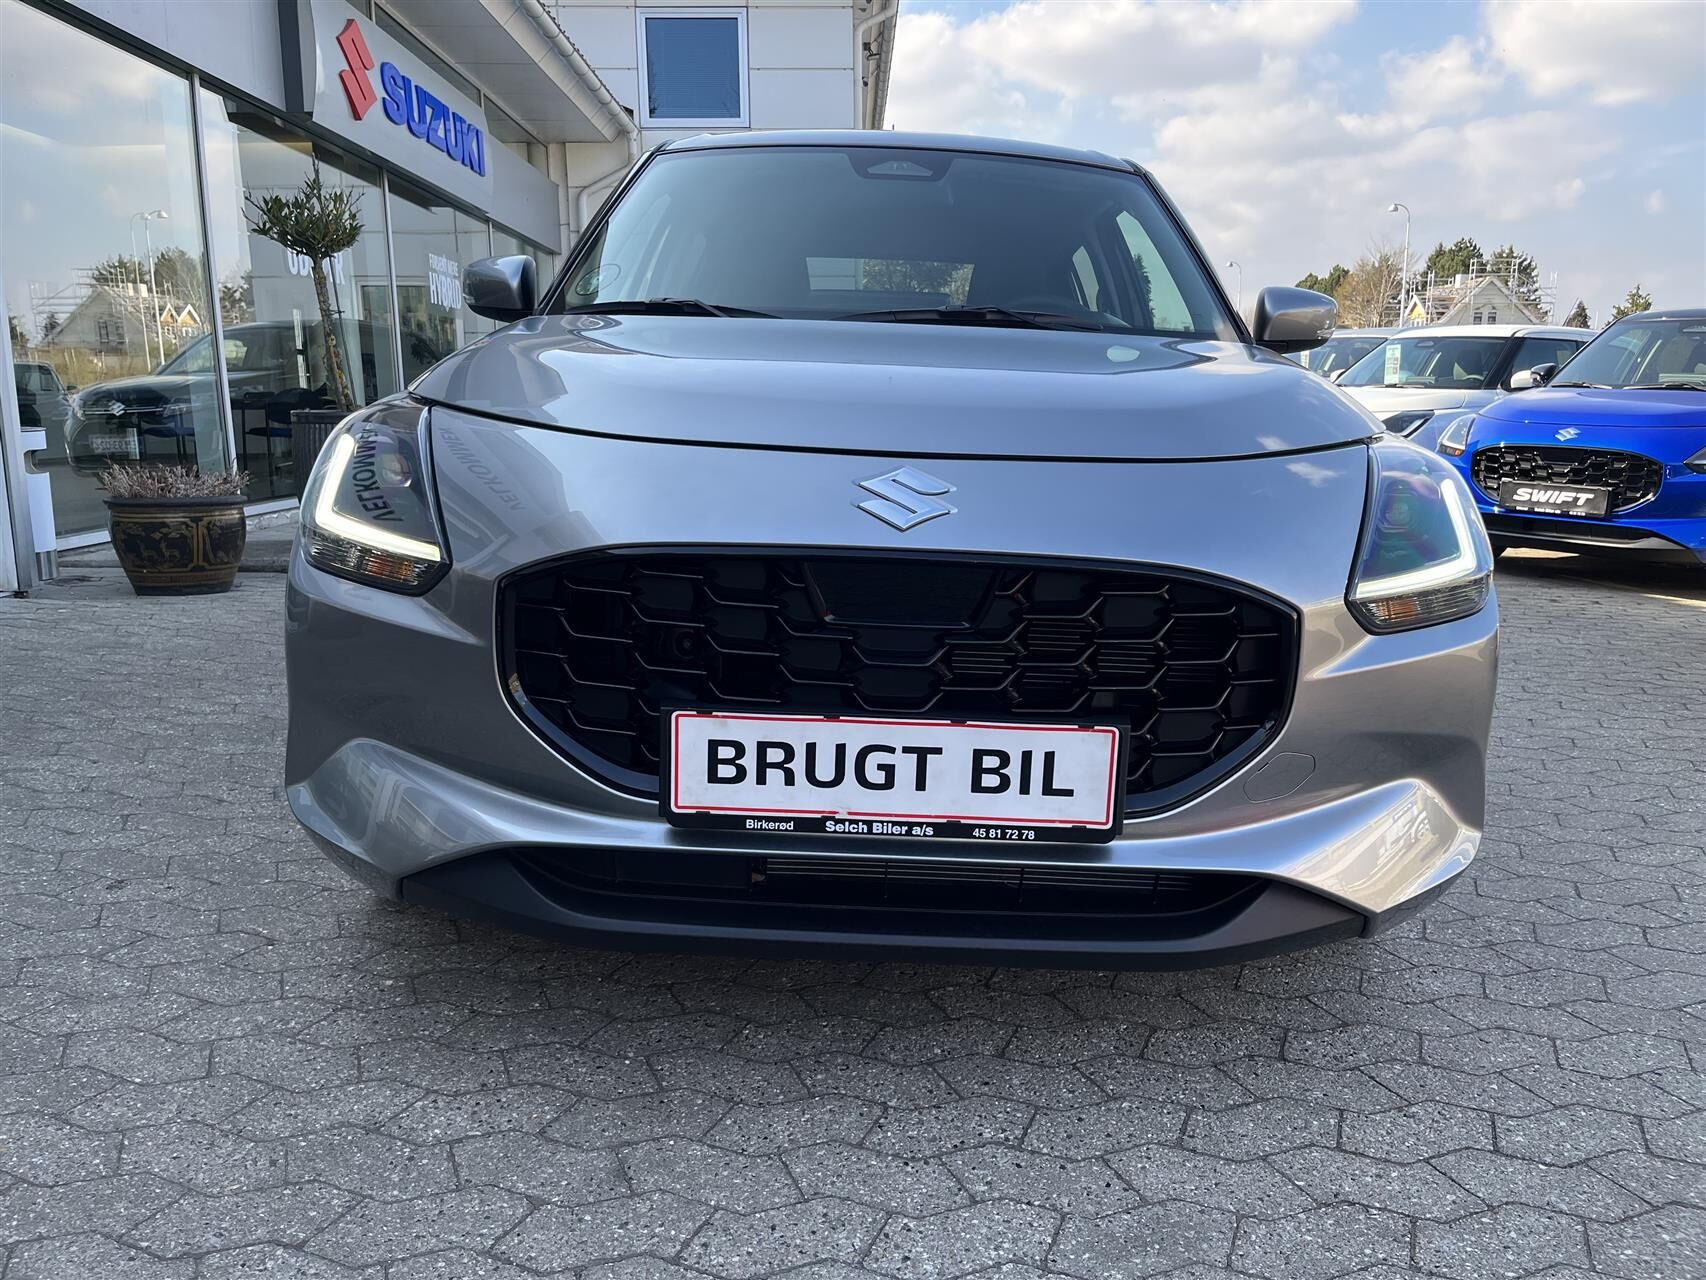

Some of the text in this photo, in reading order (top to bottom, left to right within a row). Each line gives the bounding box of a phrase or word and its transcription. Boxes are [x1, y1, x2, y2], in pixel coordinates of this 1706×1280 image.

[380, 62, 486, 177] SUZUKI
[429, 271, 462, 310] HYBRID
[1512, 488, 1595, 506] SWIFT
[707, 739, 1075, 797] BRUGT BIL
[746, 819, 1035, 840] Birkerød Selch Biler a/s 45 81 72 78
